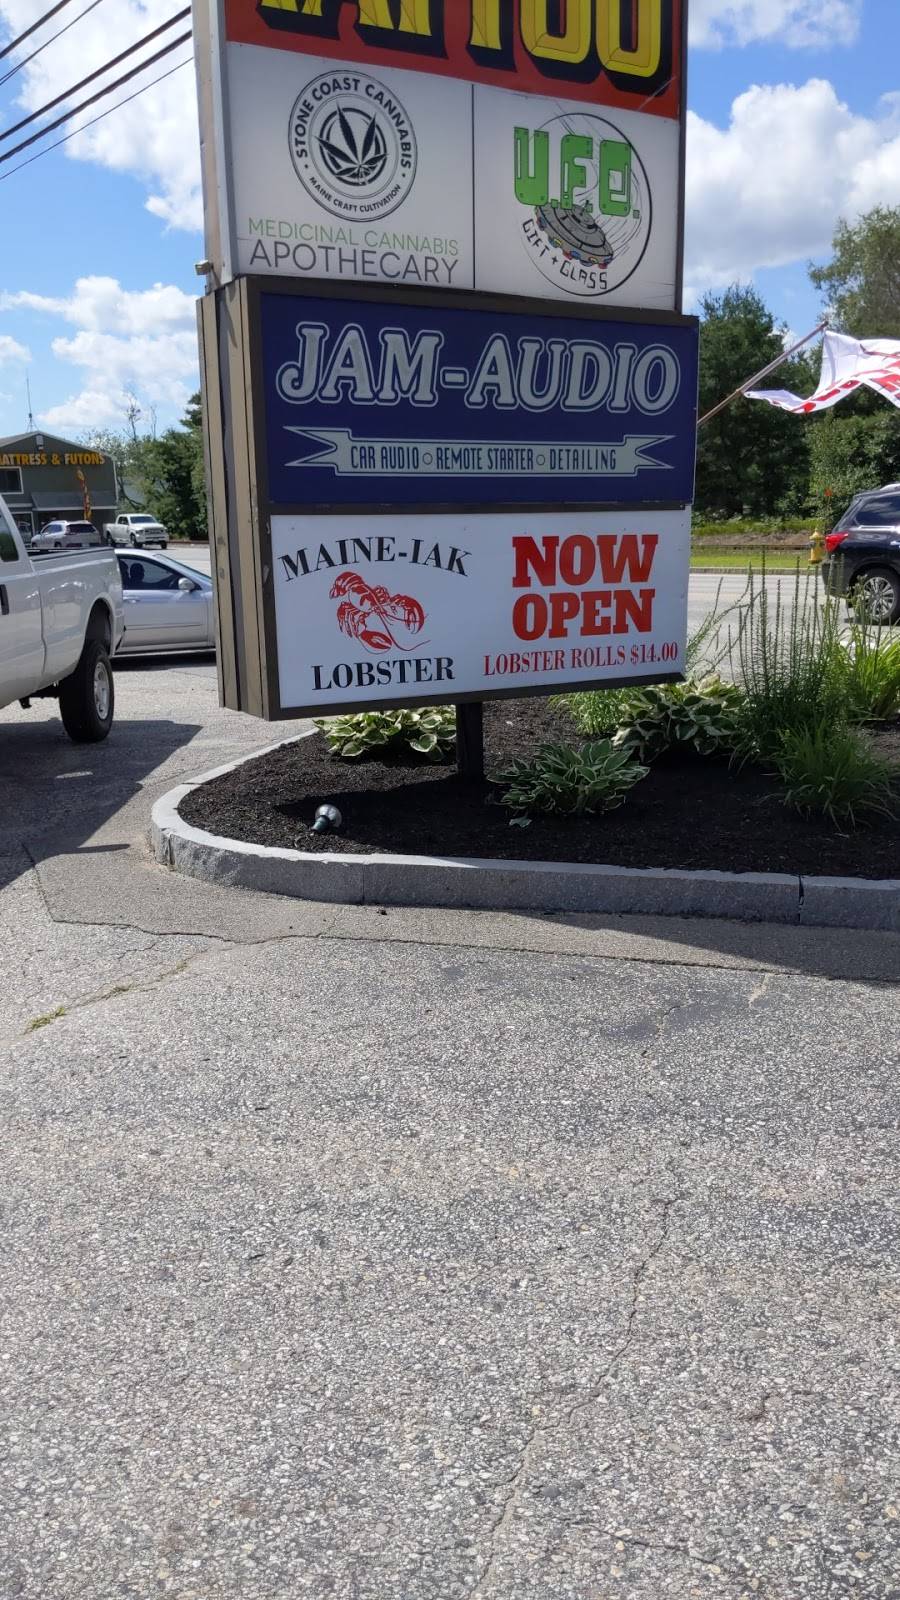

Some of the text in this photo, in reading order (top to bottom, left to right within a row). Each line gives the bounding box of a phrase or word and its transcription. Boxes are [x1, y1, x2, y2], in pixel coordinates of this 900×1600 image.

[294, 77, 412, 169] STONE COAST CANNABIS
[309, 176, 402, 213] MAINE CRAFT CULTIVATION
[248, 216, 459, 257] MEDICINAL CANNABIS
[522, 218, 550, 257] GIFT
[559, 261, 608, 290] GLASS
[249, 238, 459, 284] APOTHECARY
[276, 321, 681, 416] JAM-AUDIO
[51, 453, 60, 465] &
[64, 452, 105, 465] FUTONS
[351, 446, 617, 470] CAR AUDIO REMOTE STARTER DETAILING
[277, 536, 473, 582] MAINE-IAK
[512, 534, 659, 588] NOW
[512, 588, 656, 641] OPEN
[311, 657, 456, 691] LOBSTER
[483, 642, 679, 676] LOBSTER ROLLS $14.00
